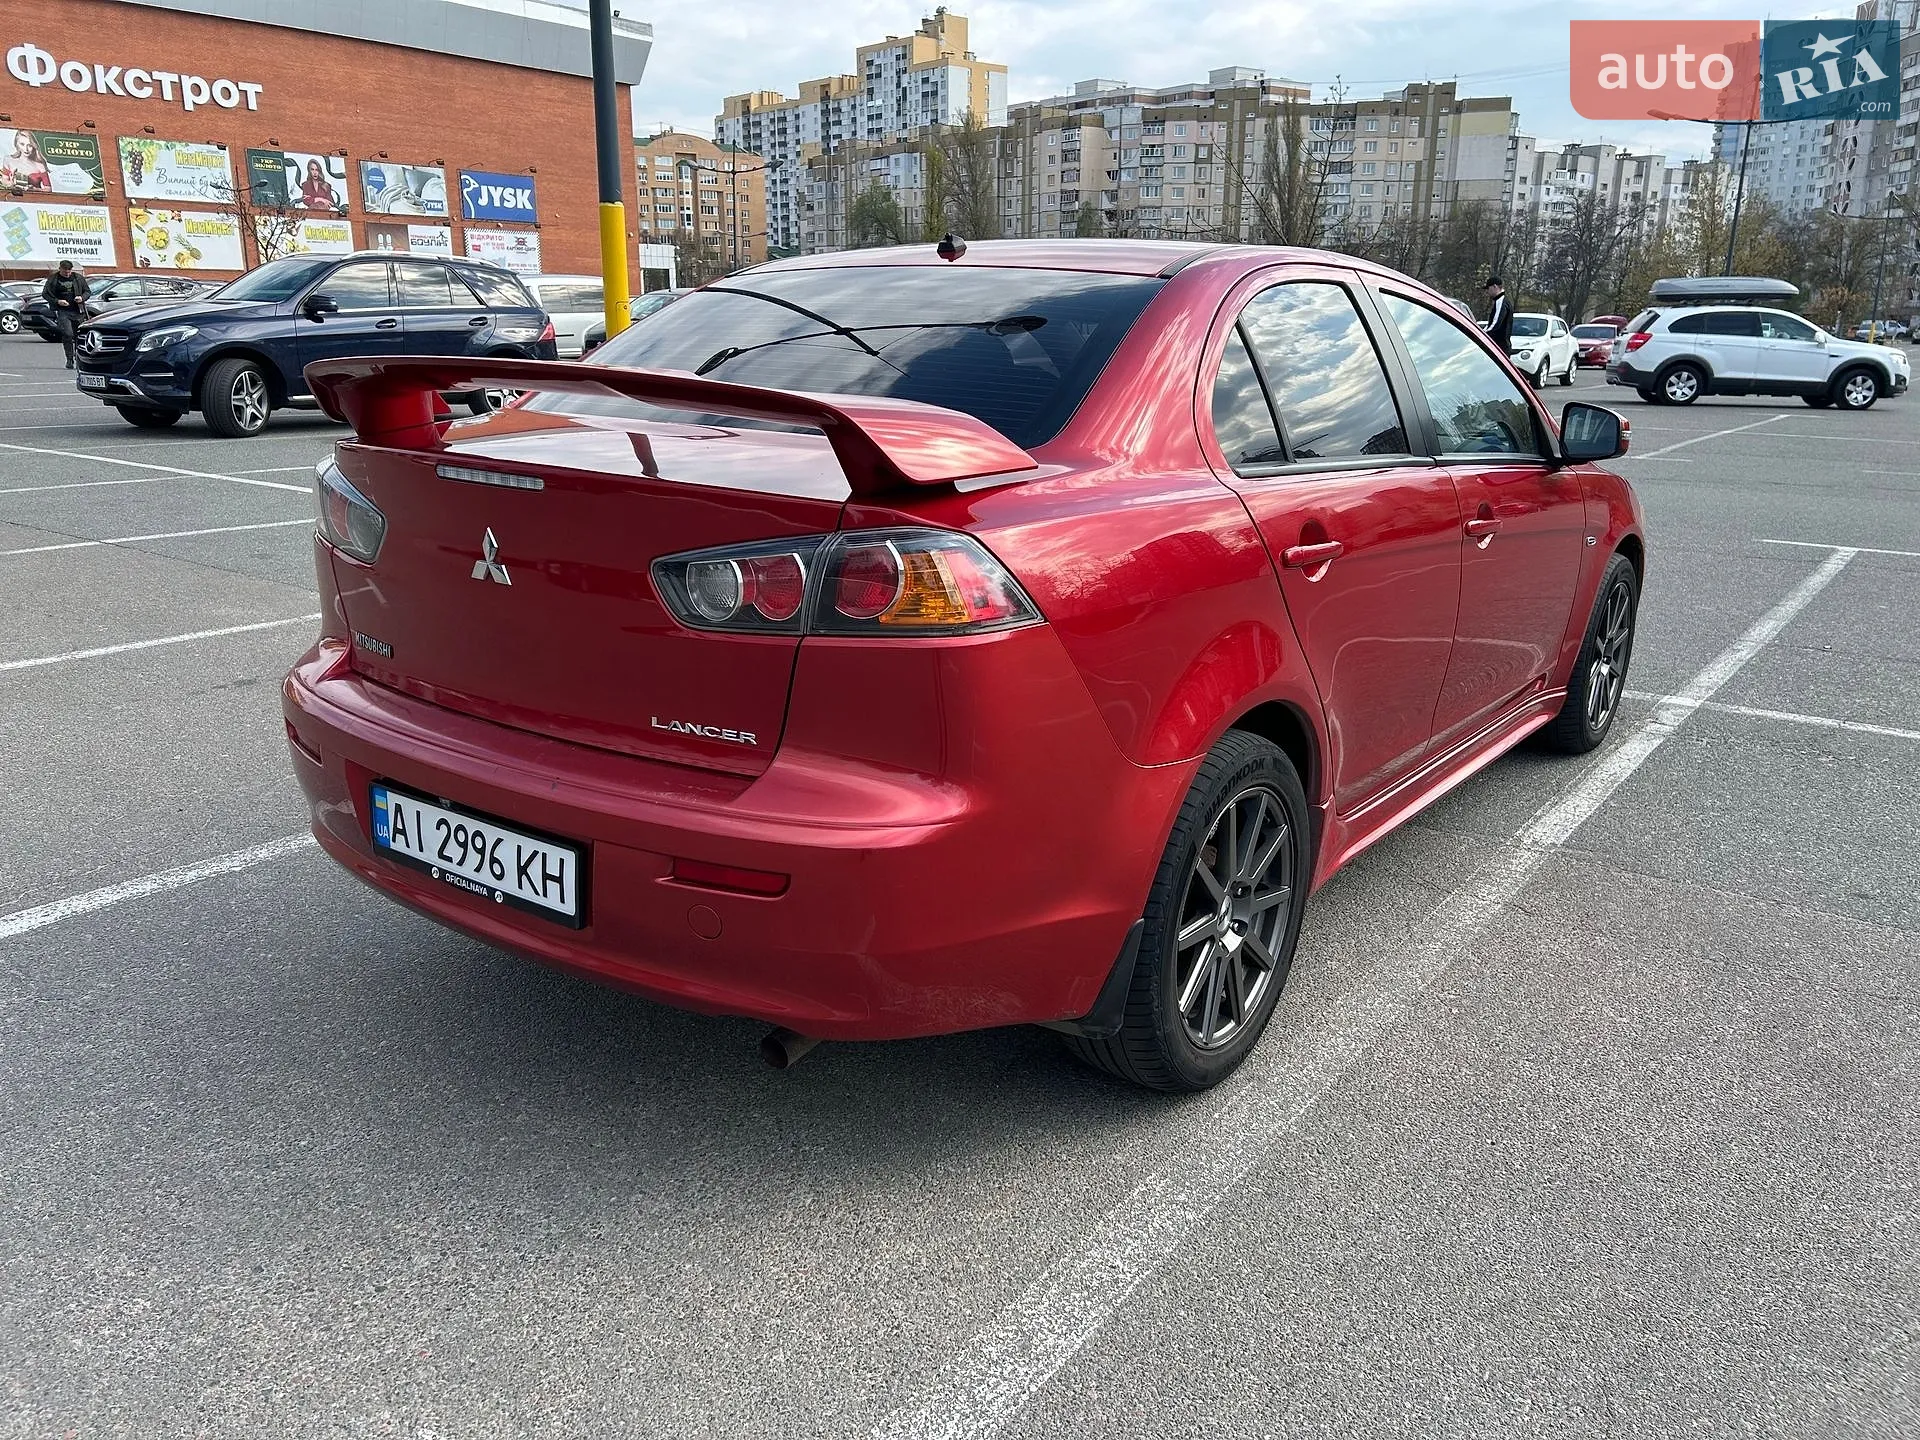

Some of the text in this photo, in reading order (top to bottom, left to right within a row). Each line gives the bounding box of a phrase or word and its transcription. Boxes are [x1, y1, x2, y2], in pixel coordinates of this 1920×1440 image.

[6, 43, 263, 111] Фокстрот
[47, 147, 93, 157] ЗОЛОТО
[58, 140, 80, 148] УКР
[477, 185, 533, 210] JYSK
[49, 236, 102, 246] ПОДАРУНКОВИЙ
[57, 246, 98, 255] СЕРТИФІКАТ
[355, 631, 391, 658] MITSUBISHI
[651, 716, 757, 745] LANCER
[377, 823, 389, 838] UA
[391, 803, 565, 904] AI 2996 KH
[445, 873, 488, 896] OFICIALNAYA
